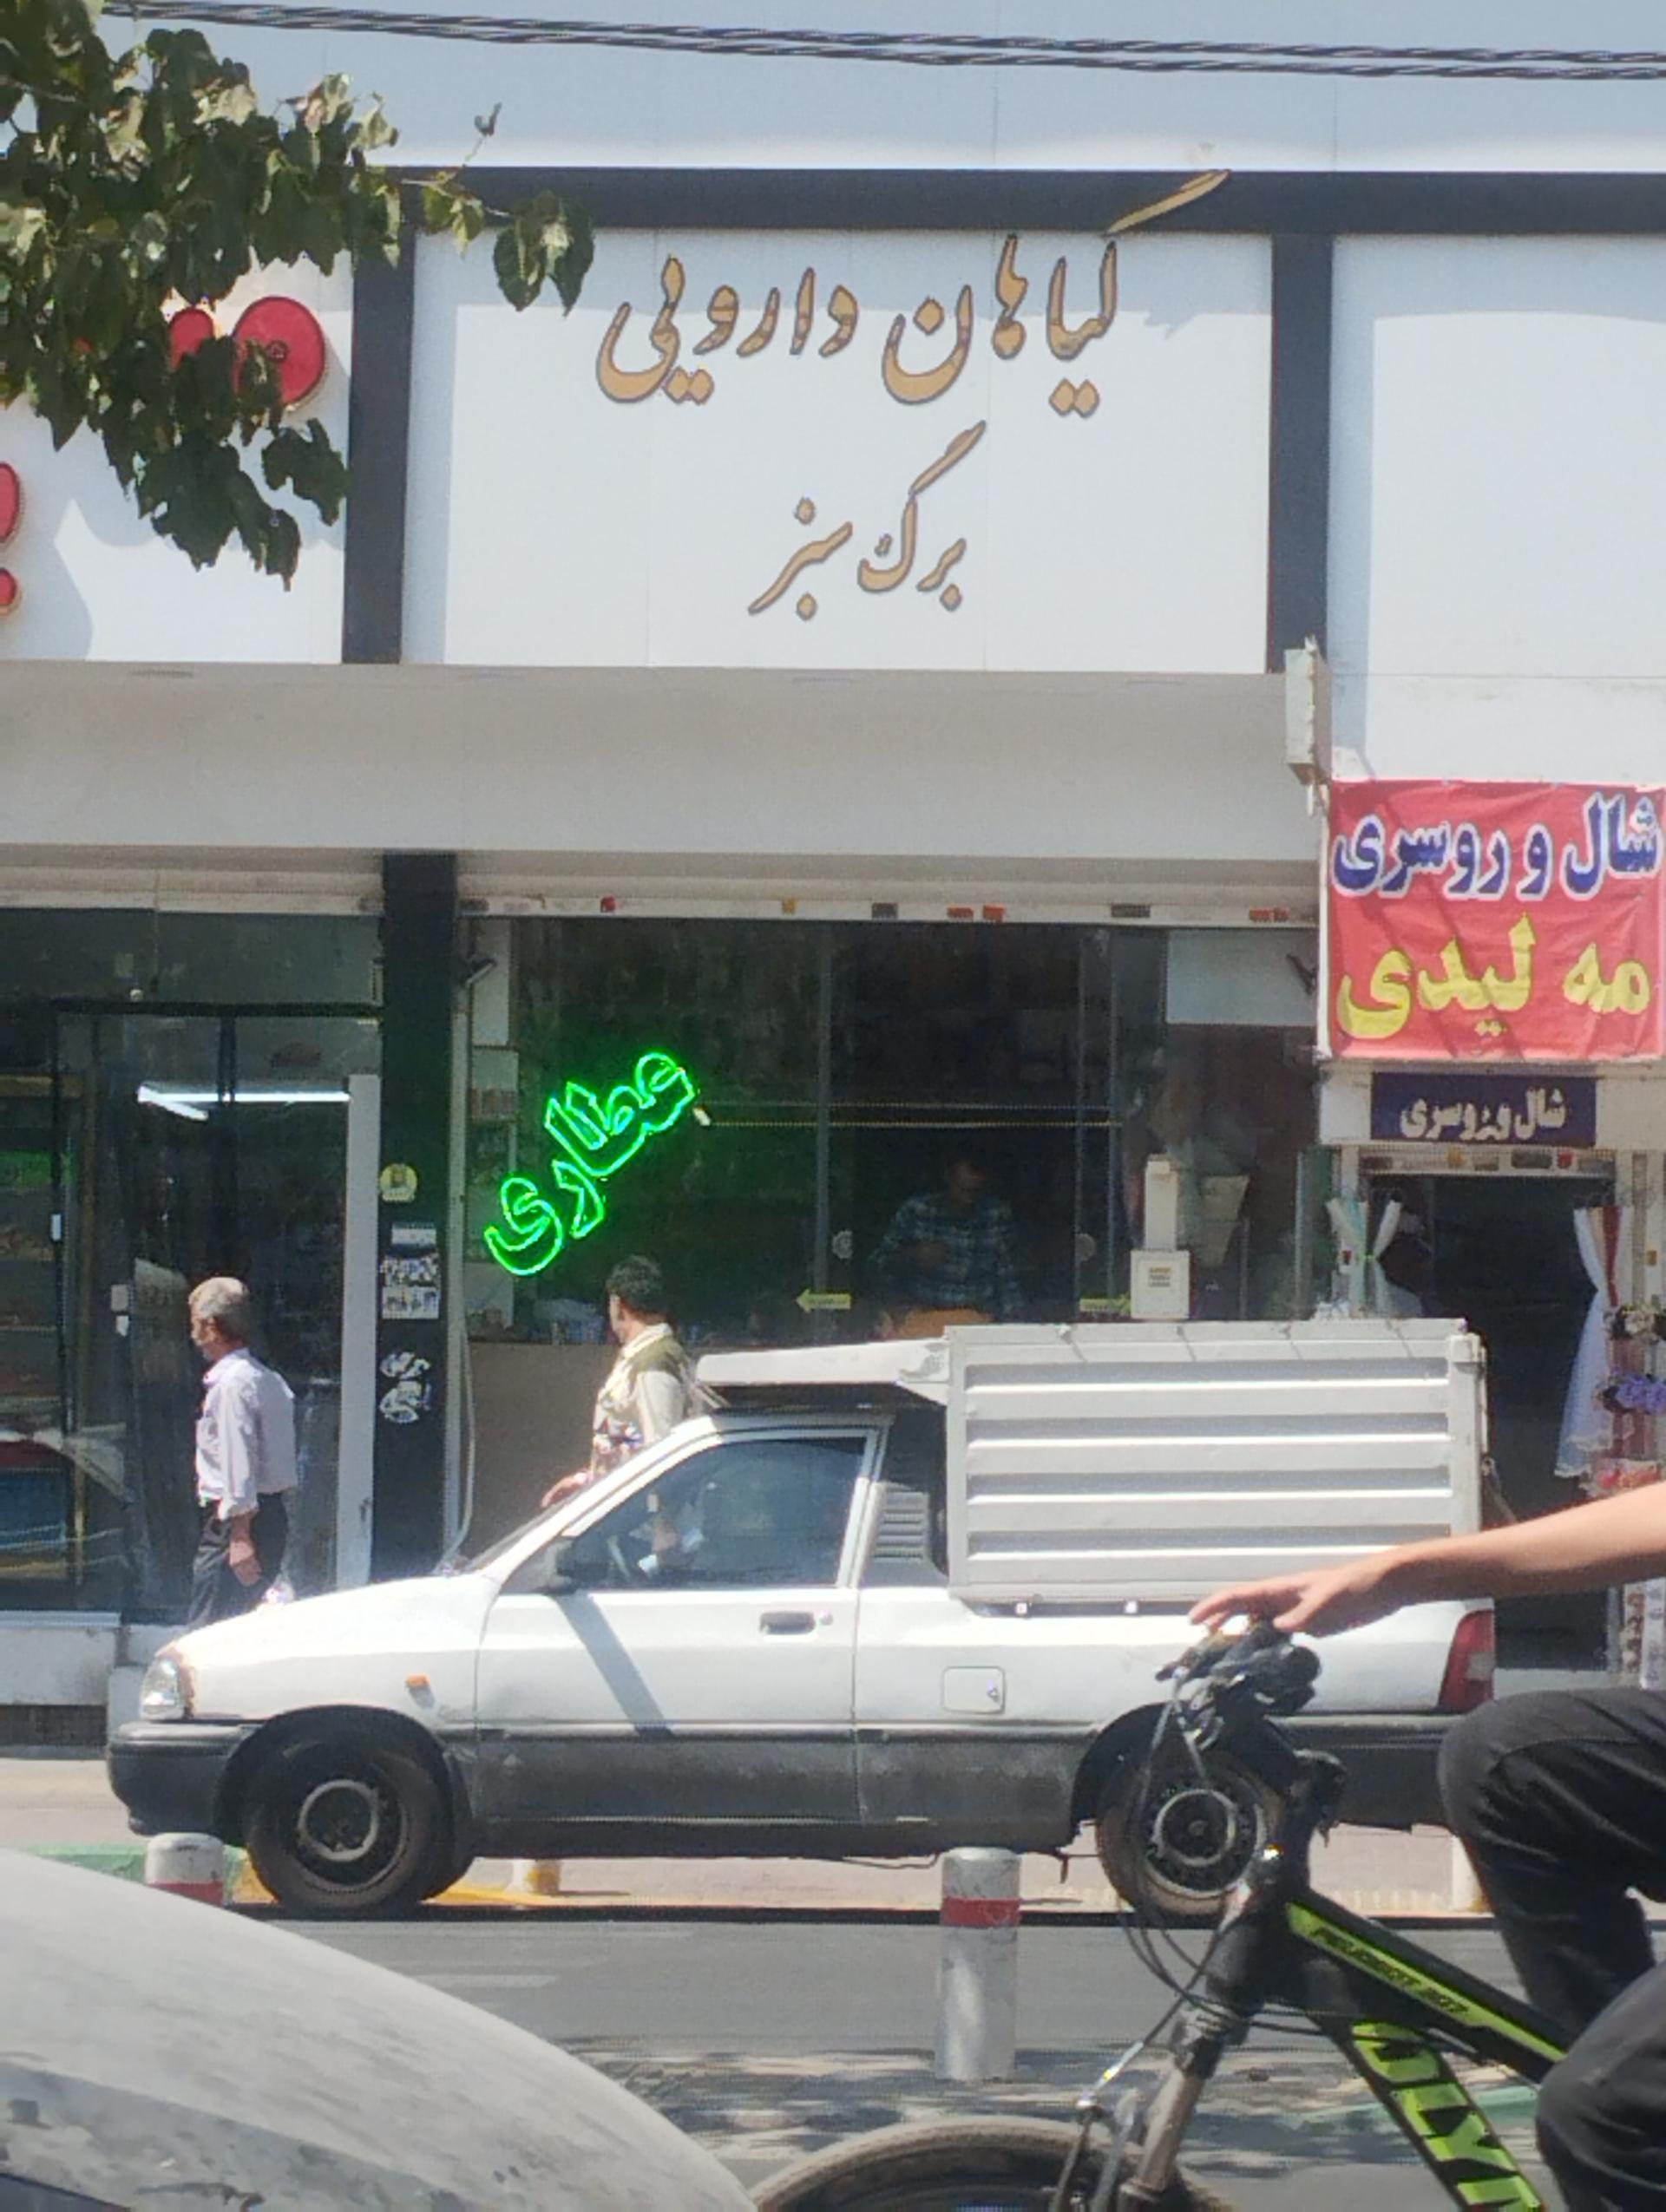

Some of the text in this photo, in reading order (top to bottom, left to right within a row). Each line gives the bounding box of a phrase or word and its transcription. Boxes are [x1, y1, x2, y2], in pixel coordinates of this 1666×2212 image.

[598, 169, 1230, 417] گیاهان دارویی
[748, 421, 986, 621] برگ سبز
[1332, 791, 1663, 900] شال و روسری
[1337, 911, 1650, 1038] مه لیدی
[484, 1052, 695, 1275] عطاری
